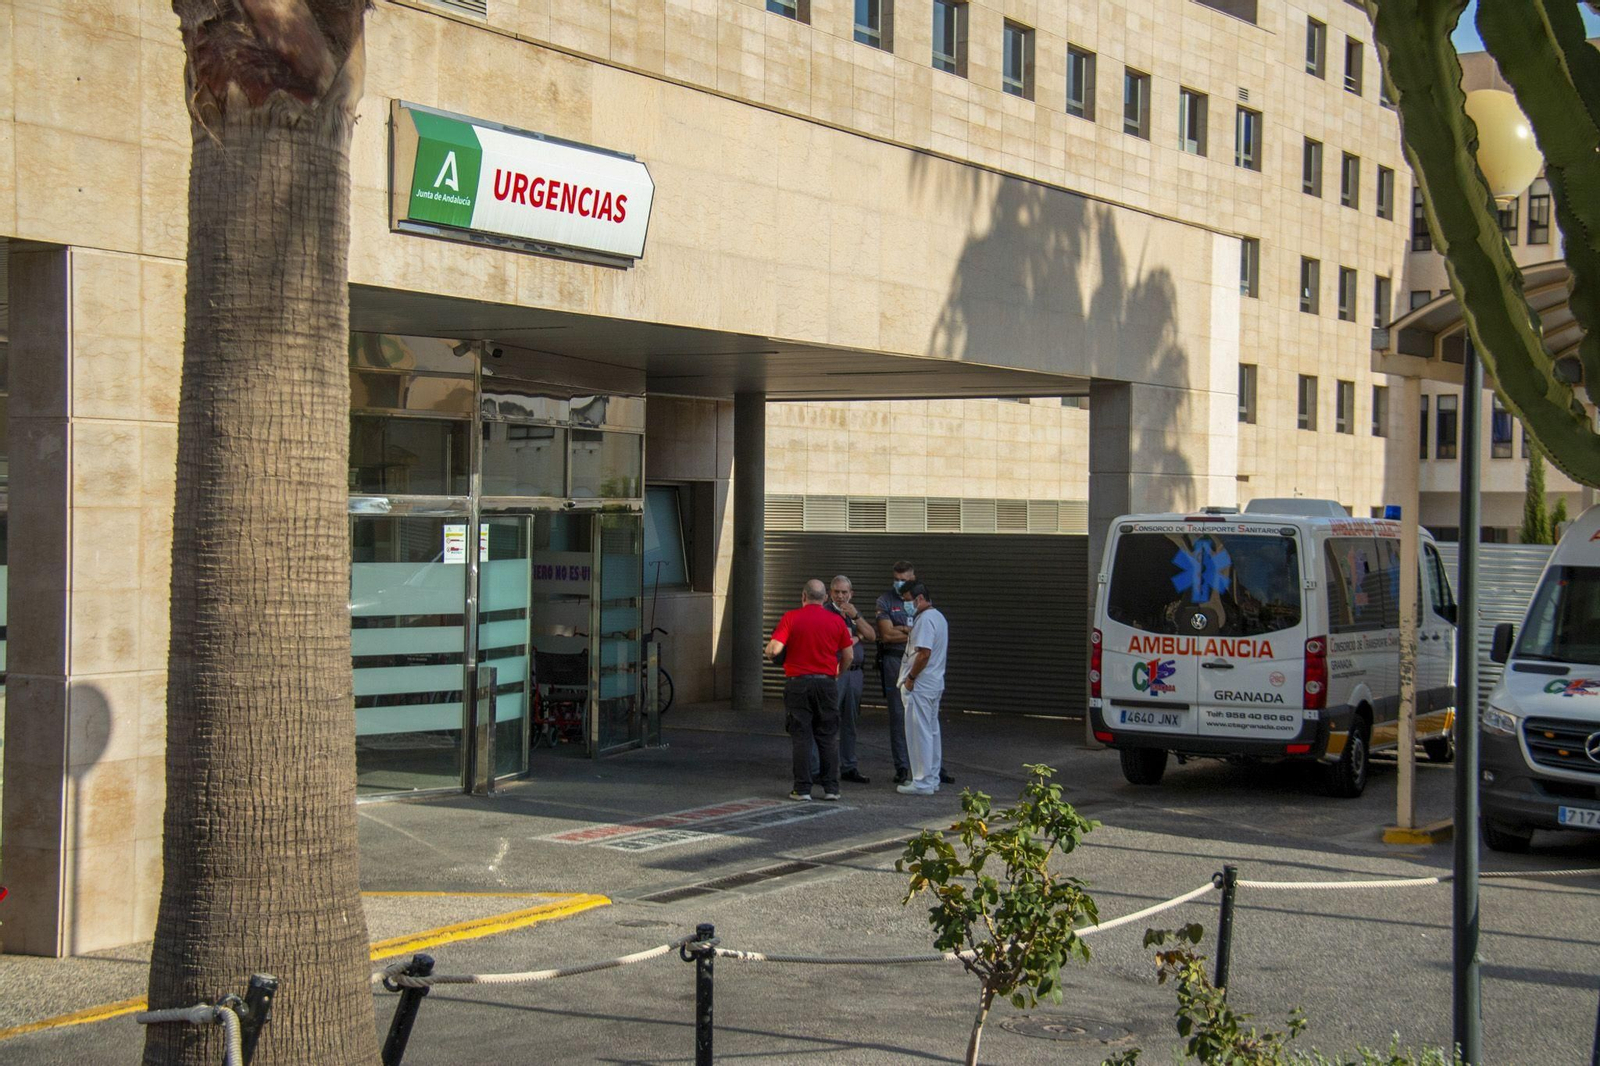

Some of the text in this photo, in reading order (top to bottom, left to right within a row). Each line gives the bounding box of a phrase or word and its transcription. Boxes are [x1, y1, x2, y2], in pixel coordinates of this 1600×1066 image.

[416, 189, 471, 206] Junta de Andalucía
[493, 168, 628, 224] URGENCIAS
[555, 565, 567, 581] NO
[569, 565, 579, 581] ES
[1128, 635, 1274, 659] AMBULANCIA
[1213, 690, 1284, 704] GRANADA
[1127, 711, 1179, 726] 4640 JNX
[1225, 711, 1246, 719] 958
[1206, 721, 1294, 731] www.ctsgranada.com
